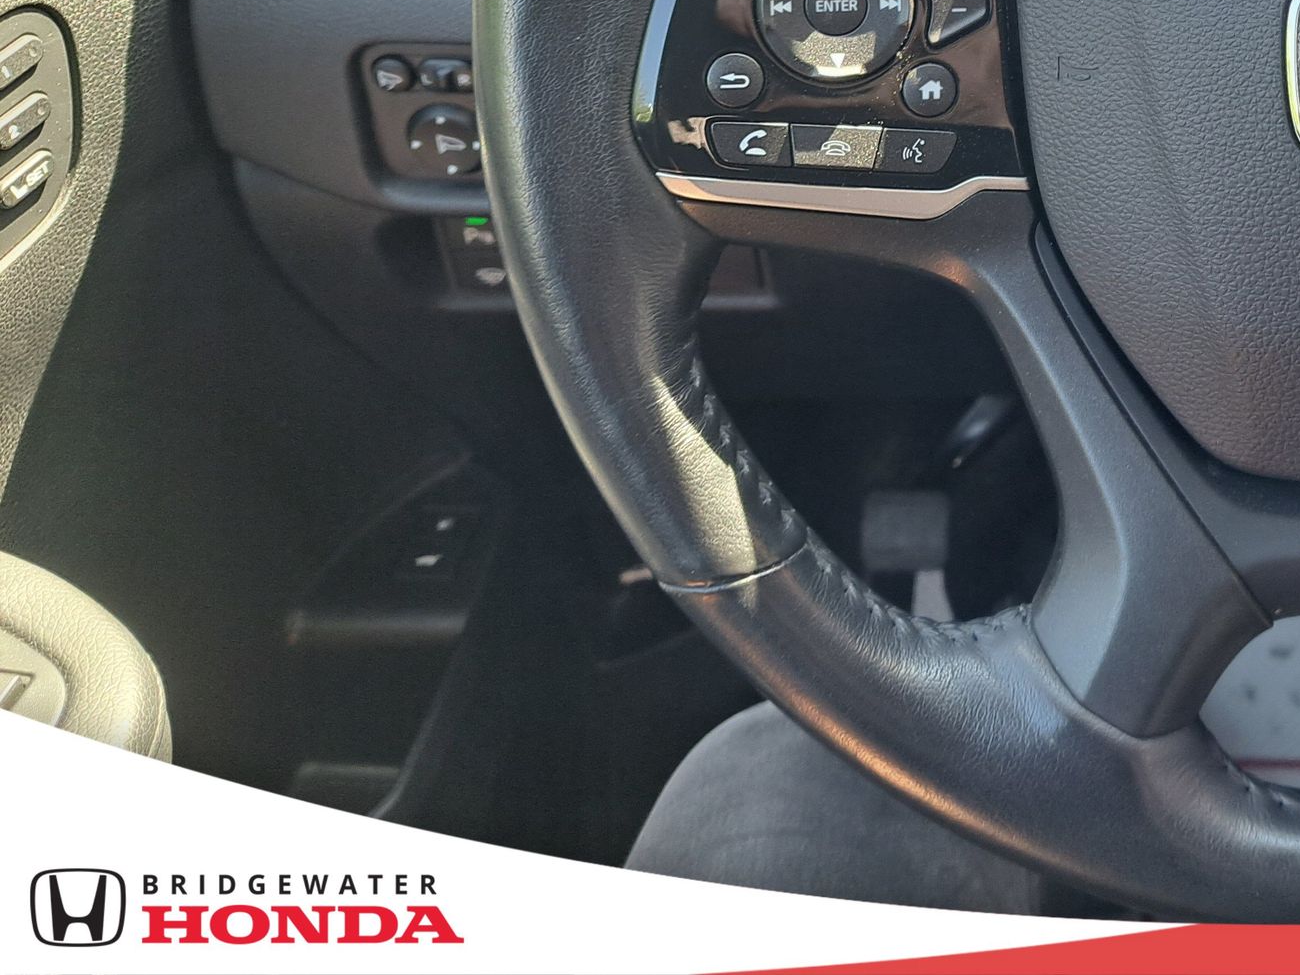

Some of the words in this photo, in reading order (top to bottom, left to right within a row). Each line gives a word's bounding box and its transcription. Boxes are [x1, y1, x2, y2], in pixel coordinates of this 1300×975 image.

[815, 0, 858, 13] ENTER
[8, 125, 20, 140] 2
[26, 162, 50, 185] SET
